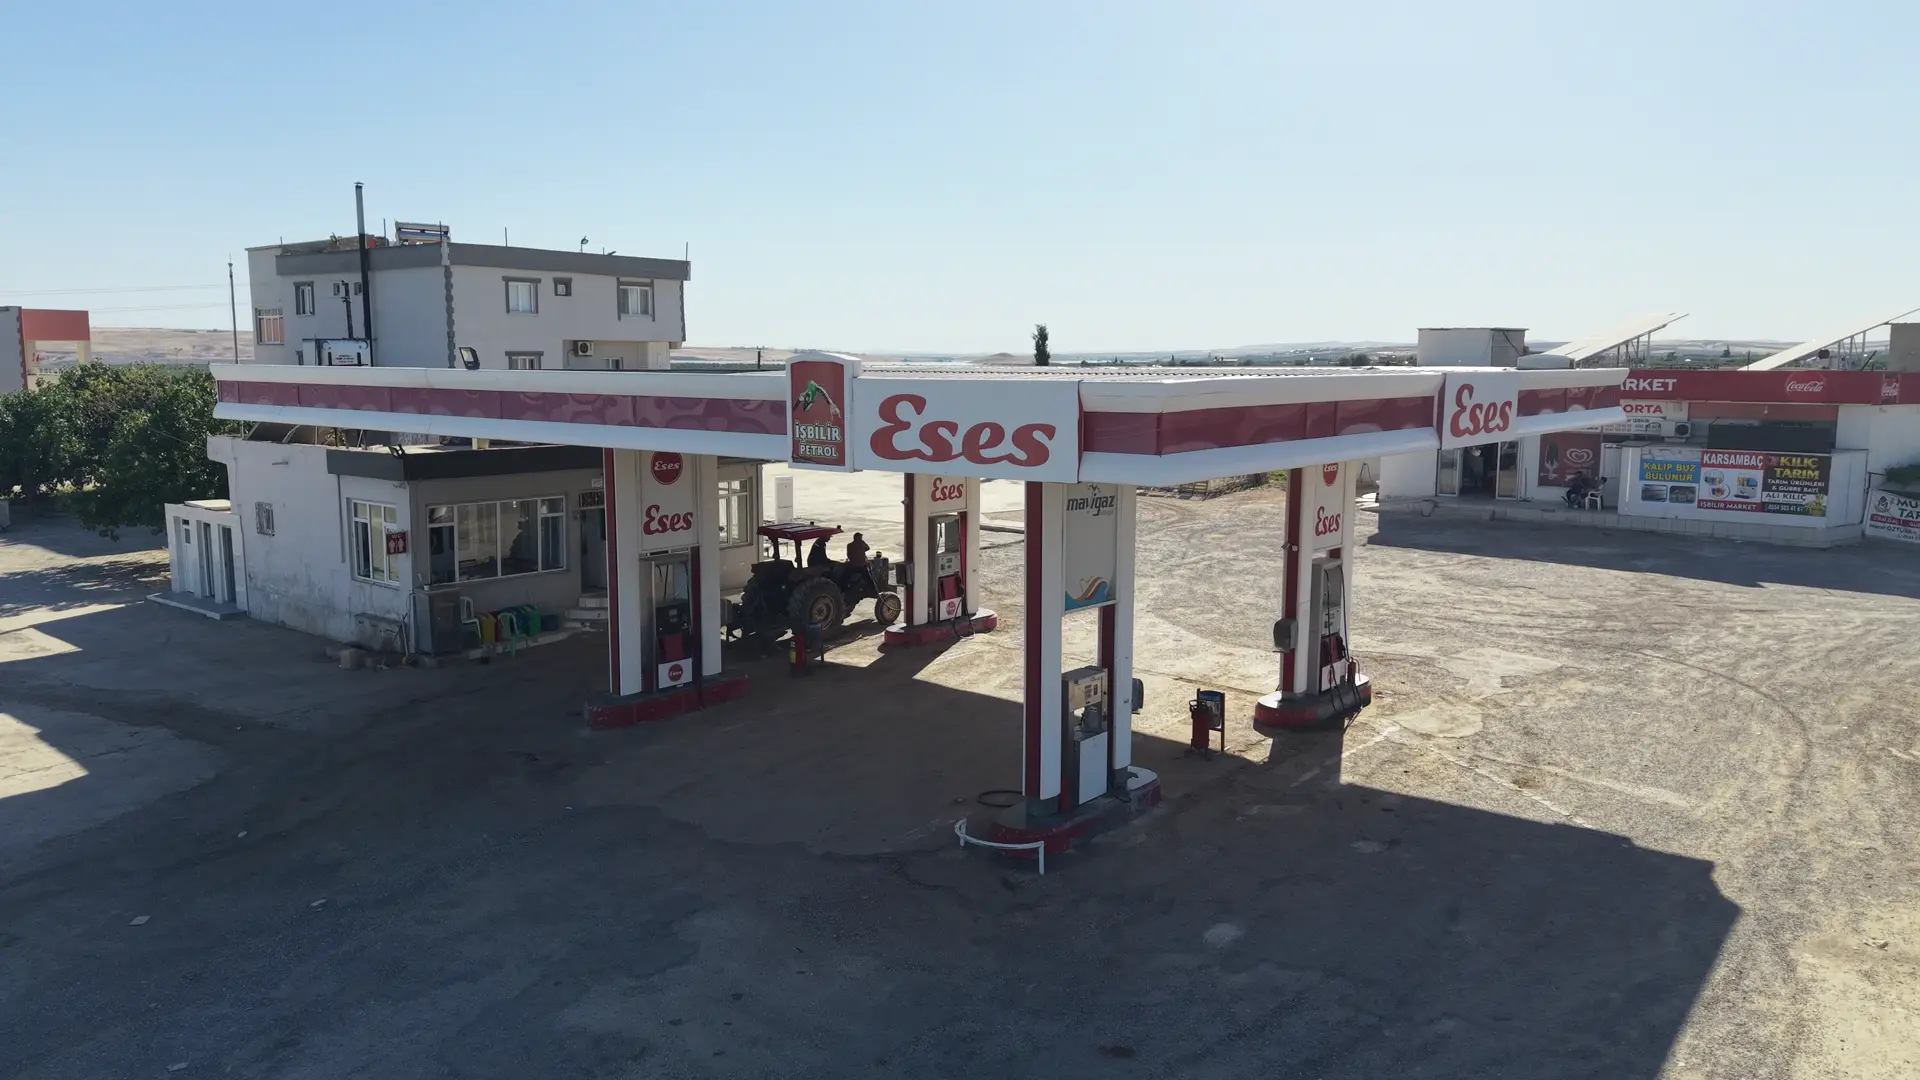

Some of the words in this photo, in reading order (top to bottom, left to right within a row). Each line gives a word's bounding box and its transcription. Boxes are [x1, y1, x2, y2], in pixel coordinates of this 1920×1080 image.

[1450, 383, 1513, 438] Eses
[795, 420, 841, 443] İŞBİLİR
[870, 393, 1056, 467] Eses
[800, 444, 838, 458] PETROL
[1704, 453, 1764, 469] KARSAMBAÇ
[654, 460, 680, 471] Eses
[1643, 462, 1673, 472] KALIP
[1676, 464, 1697, 472] BUZ
[1645, 472, 1693, 481] BULUNUR
[1774, 467, 1820, 480] TARIM
[931, 477, 963, 502] Eses
[1066, 493, 1116, 517] mavigaz
[642, 504, 694, 536] Eses
[1315, 506, 1341, 536] Eses
